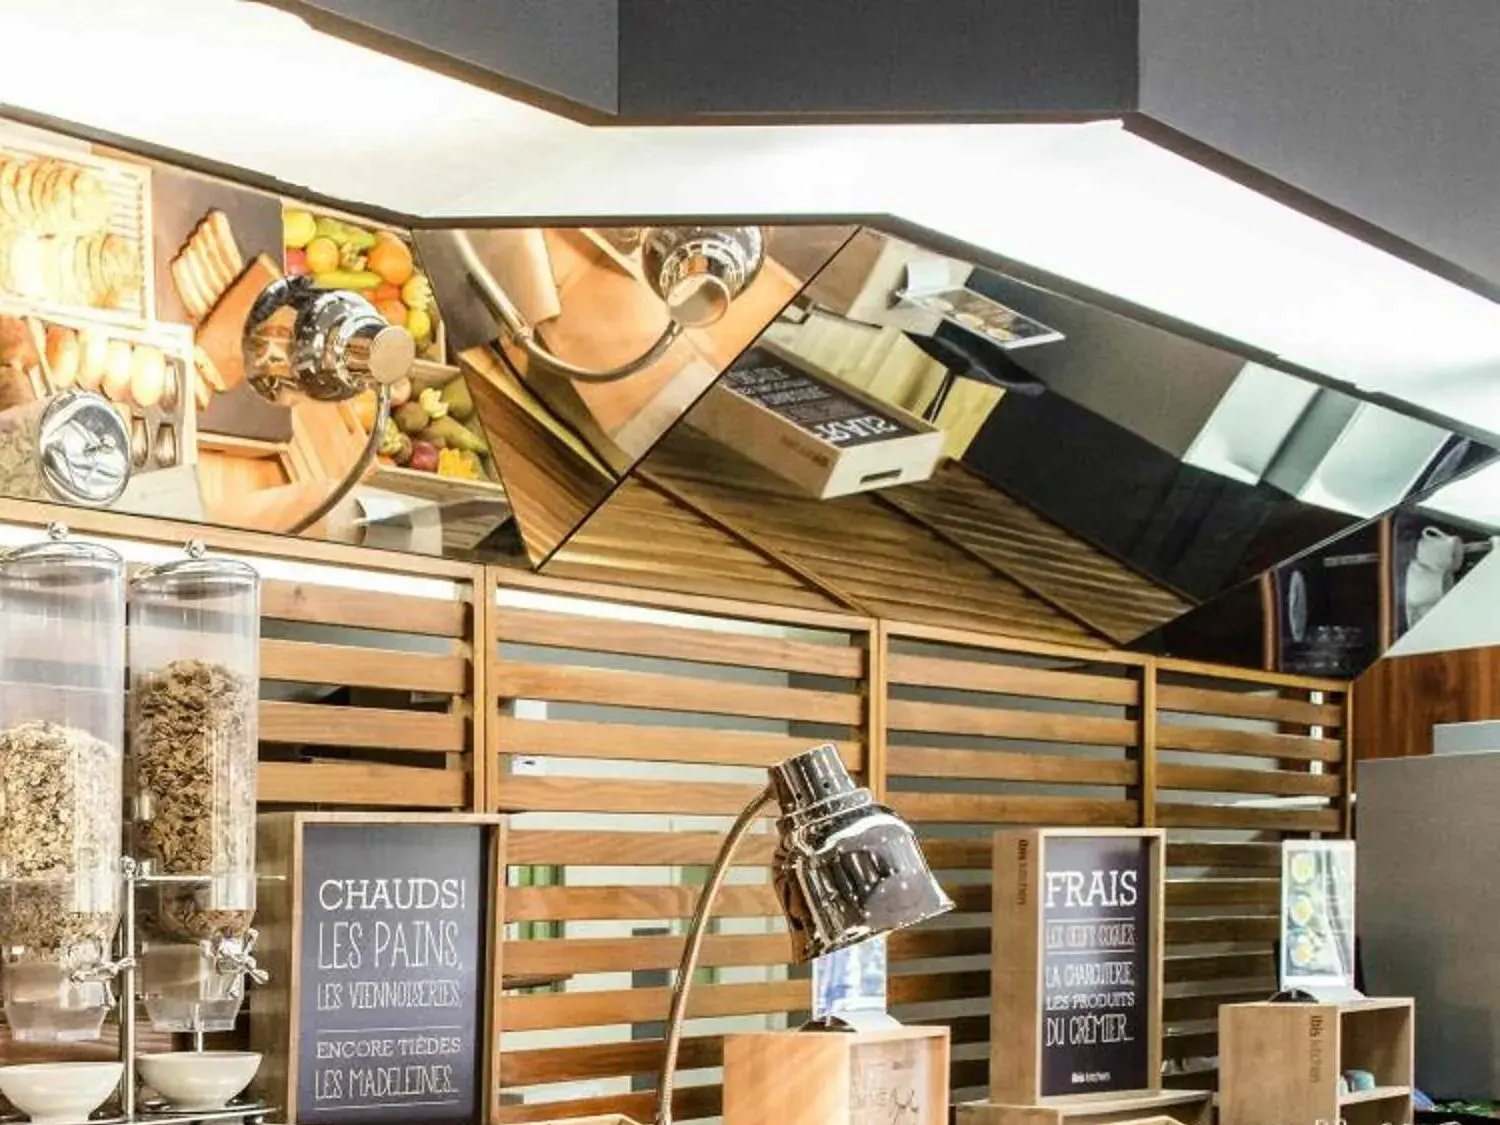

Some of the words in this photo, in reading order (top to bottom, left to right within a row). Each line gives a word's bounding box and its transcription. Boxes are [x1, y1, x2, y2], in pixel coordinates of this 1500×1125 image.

[319, 879, 466, 910] CHAUDS!
[1045, 870, 1137, 907] FRAIS
[318, 921, 364, 970] LES
[1046, 965, 1061, 988] LA
[316, 983, 343, 1011] LES
[1045, 995, 1069, 1011] LES
[1072, 991, 1135, 1009] PRODUITS
[1045, 1017, 1065, 1047] DU
[316, 1039, 394, 1060] ENCORE
[315, 1069, 343, 1101] LES
